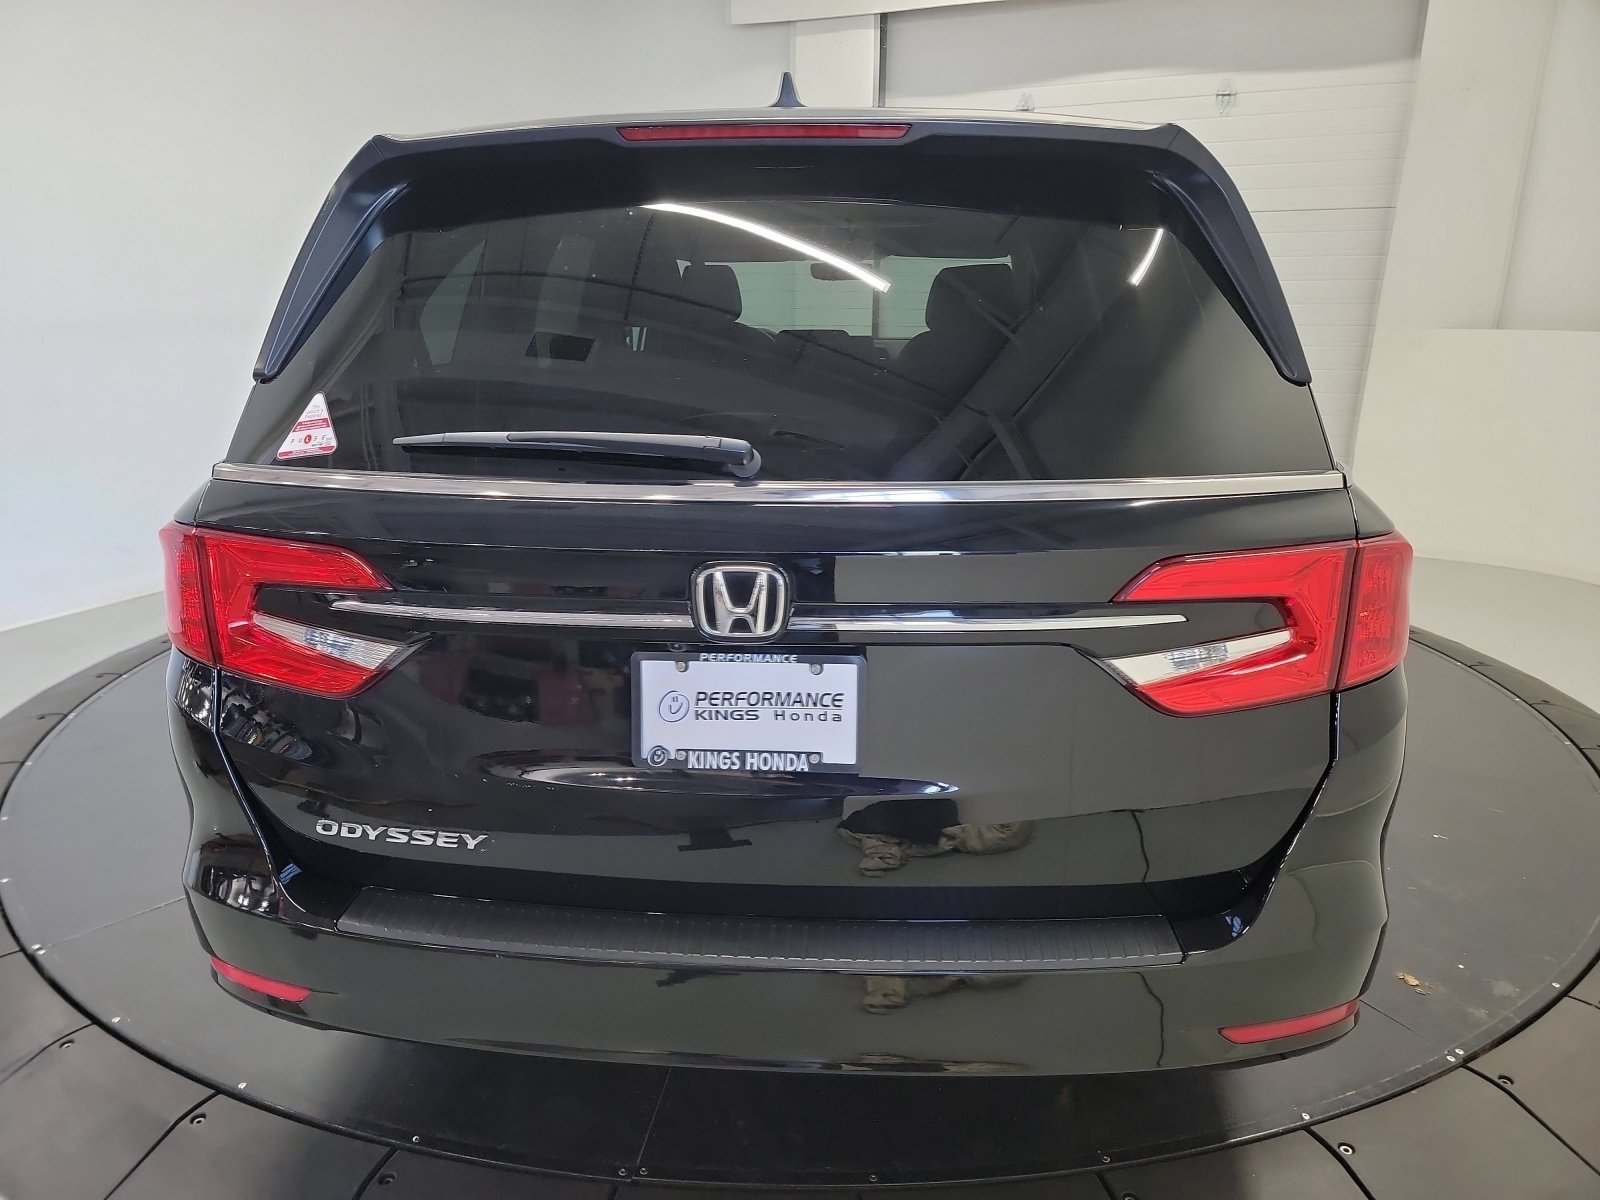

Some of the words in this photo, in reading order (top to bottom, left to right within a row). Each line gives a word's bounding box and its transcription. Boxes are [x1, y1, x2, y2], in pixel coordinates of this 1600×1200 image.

[699, 652, 798, 663] PERFORMANCE
[694, 691, 845, 708] PERFORMANCE
[694, 709, 760, 721] KINGS
[774, 710, 842, 722] Honda
[687, 751, 740, 770] KINGS
[744, 752, 809, 772] HONDA
[315, 819, 489, 850] ODYSSEY
